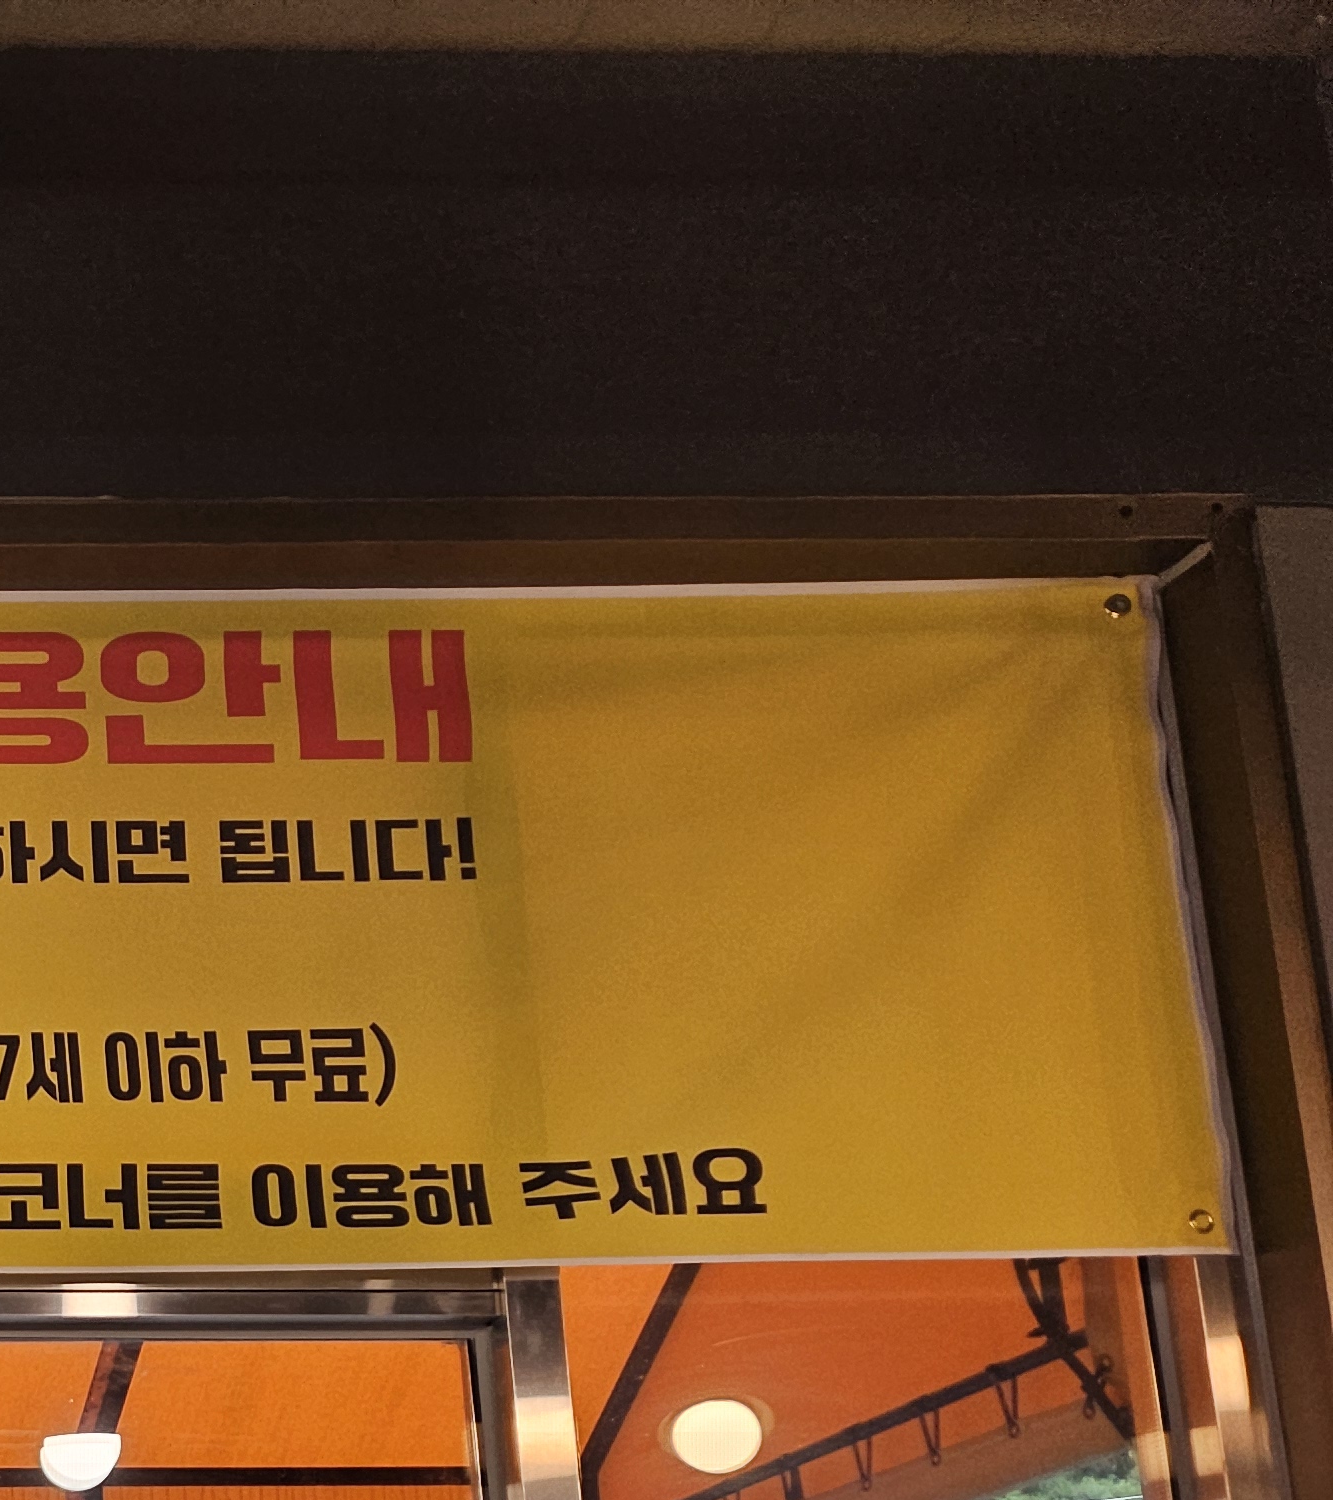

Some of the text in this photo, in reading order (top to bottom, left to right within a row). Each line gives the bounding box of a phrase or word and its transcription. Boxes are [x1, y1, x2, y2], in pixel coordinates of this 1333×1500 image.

[219, 816, 477, 883] 됩니다!
[104, 1031, 228, 1103] 이하
[247, 1022, 396, 1107] 무료)
[251, 1163, 492, 1229] 이용해
[518, 1147, 767, 1220] 주세요
